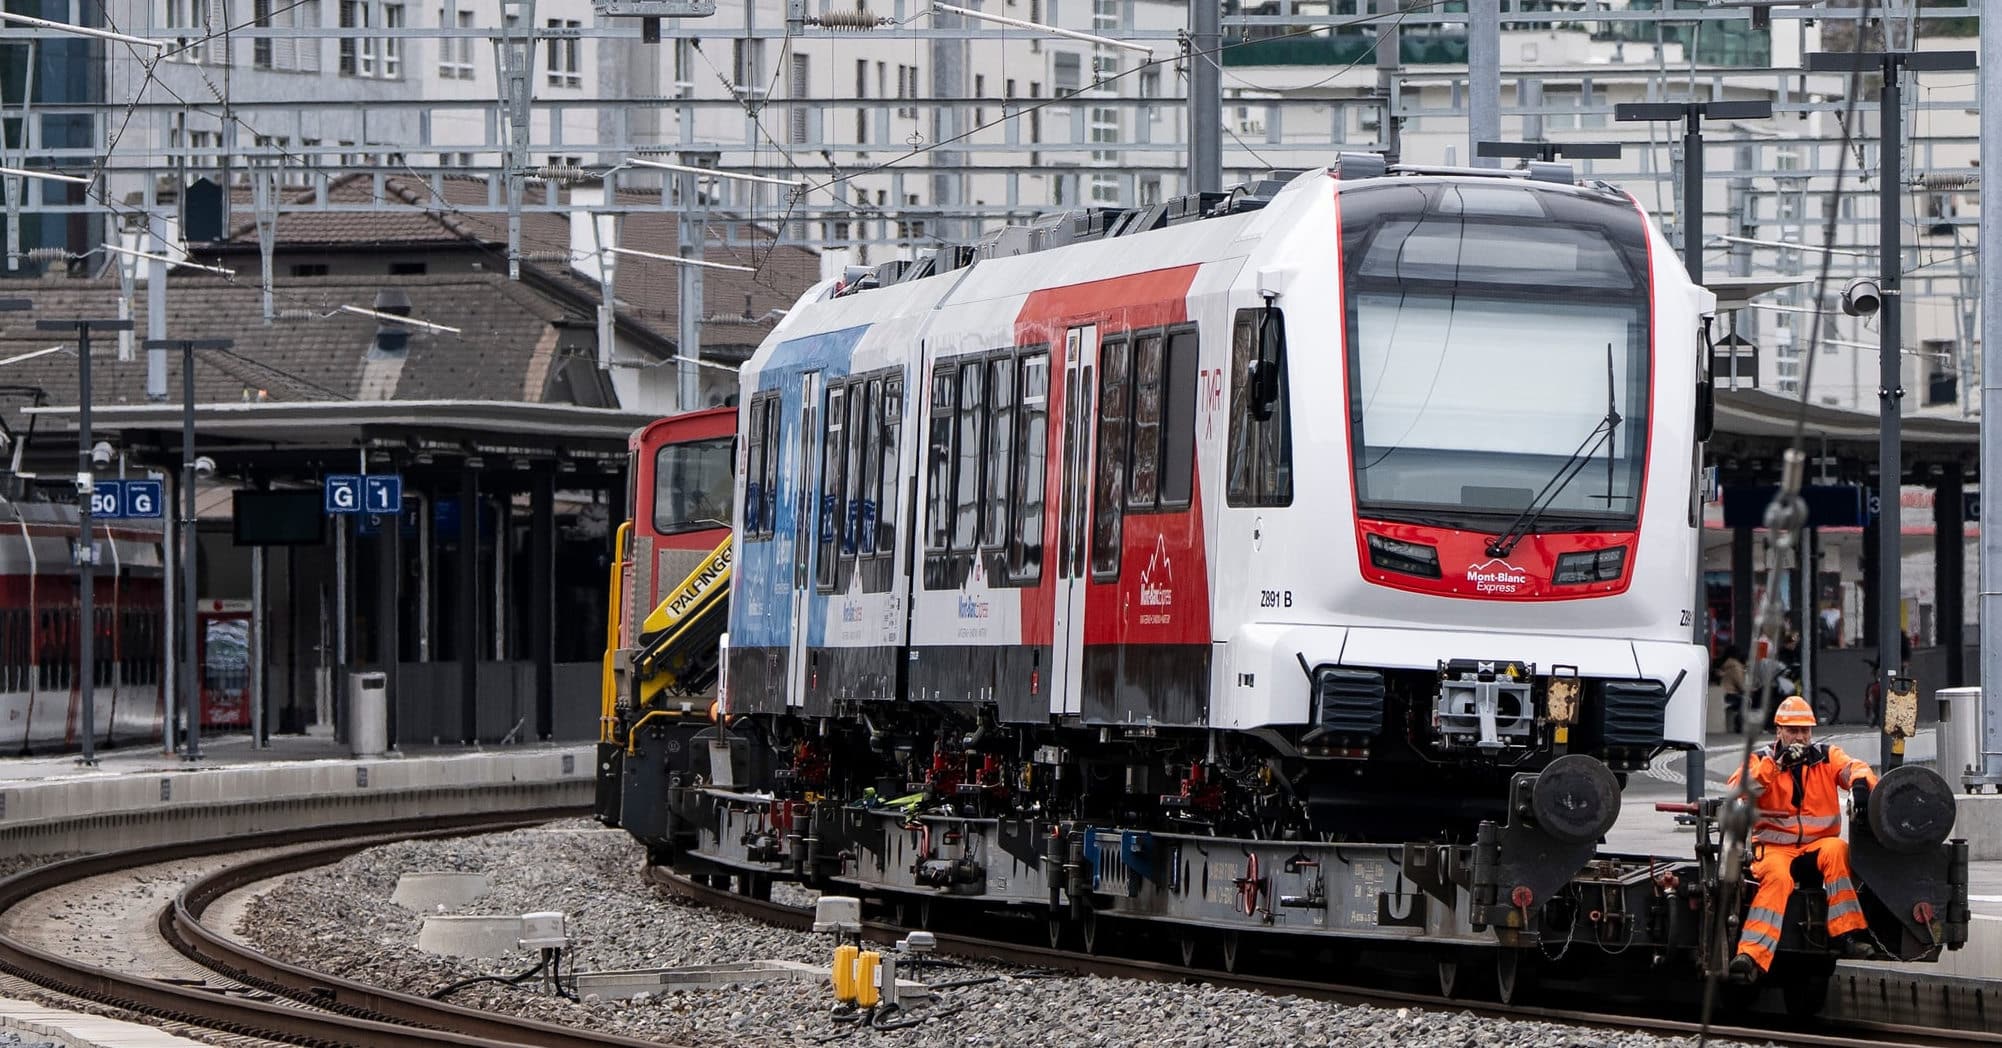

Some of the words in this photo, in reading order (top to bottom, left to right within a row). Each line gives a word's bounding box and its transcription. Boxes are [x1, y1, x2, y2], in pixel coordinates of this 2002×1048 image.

[135, 494, 151, 512] G
[334, 487, 353, 507] G
[377, 487, 388, 508] 1
[1467, 571, 1526, 583] Mont-Blanc
[1477, 581, 1516, 595] Express
[1261, 590, 1281, 608] Z891
[1285, 590, 1293, 608] B
